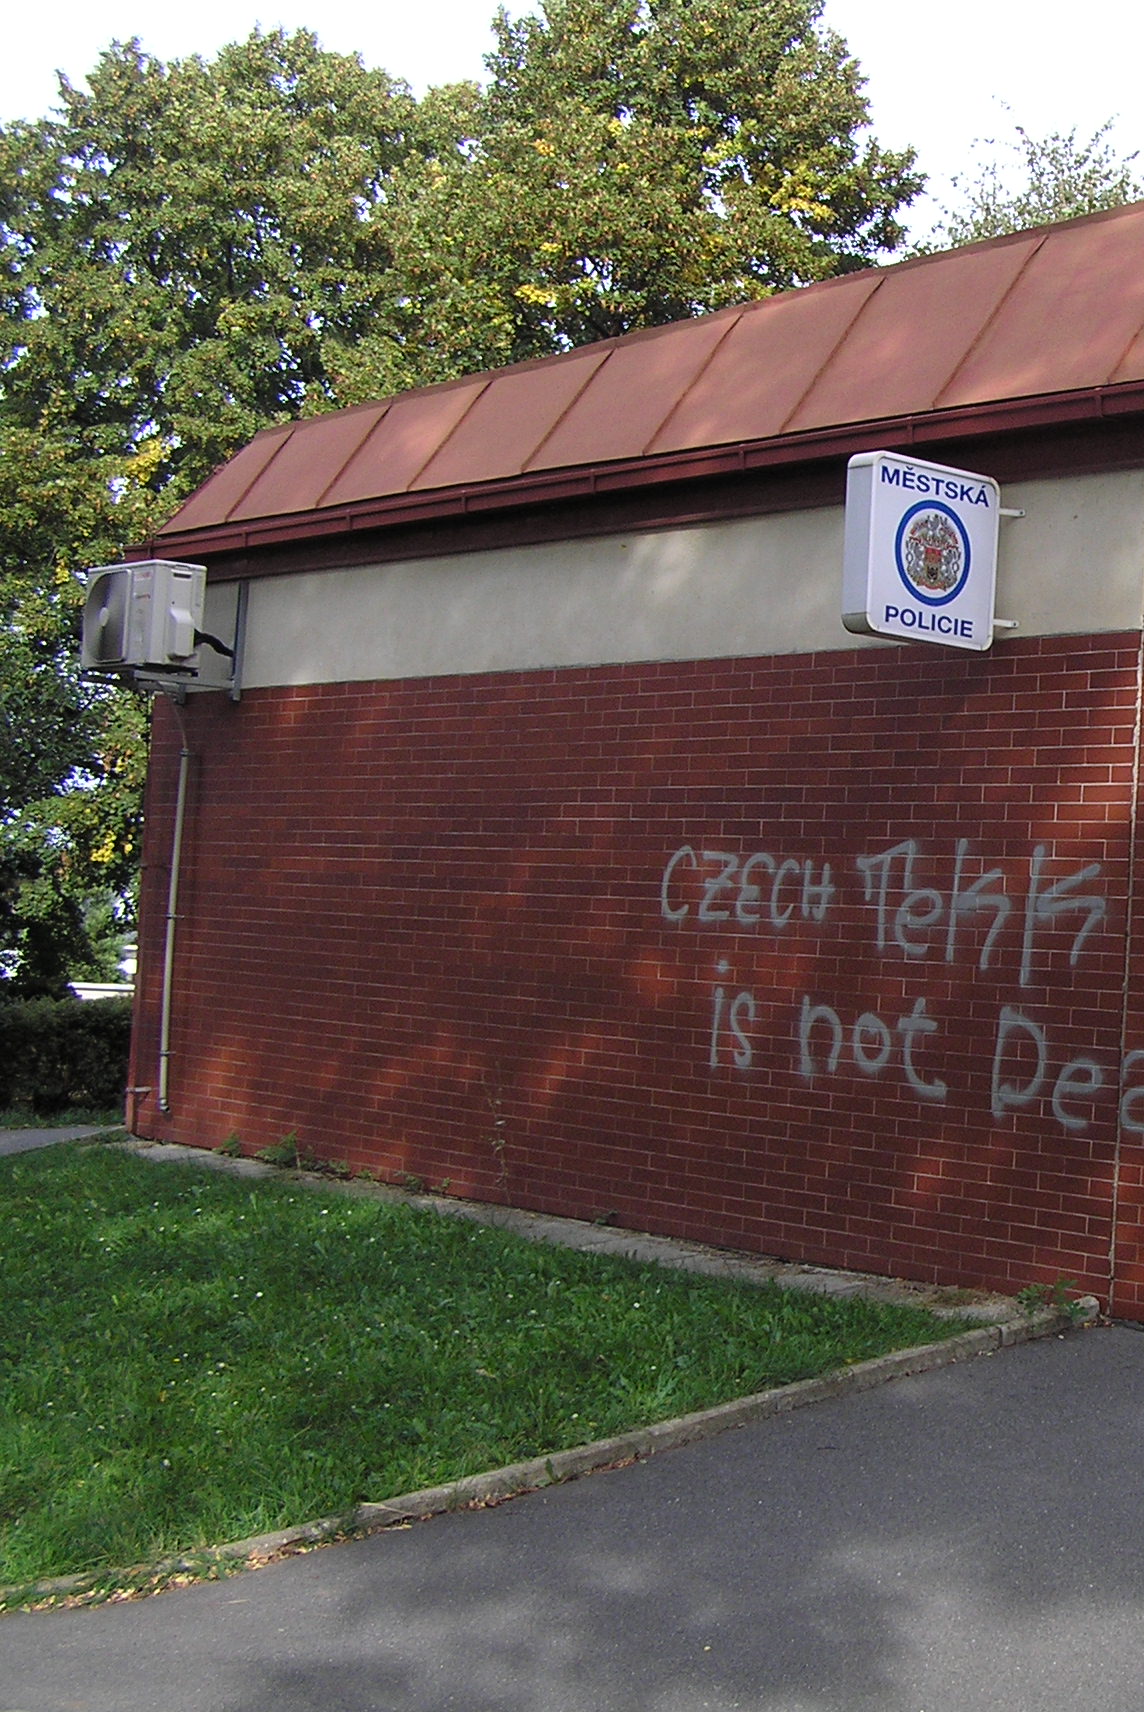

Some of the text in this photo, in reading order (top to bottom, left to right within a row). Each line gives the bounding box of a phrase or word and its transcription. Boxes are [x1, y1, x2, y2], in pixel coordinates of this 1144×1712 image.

[881, 465, 990, 507] MĚSTSKÁ
[884, 605, 973, 638] POLICIE
[659, 844, 836, 927] CZECH
[708, 958, 758, 1068] is
[799, 997, 948, 1100] not
